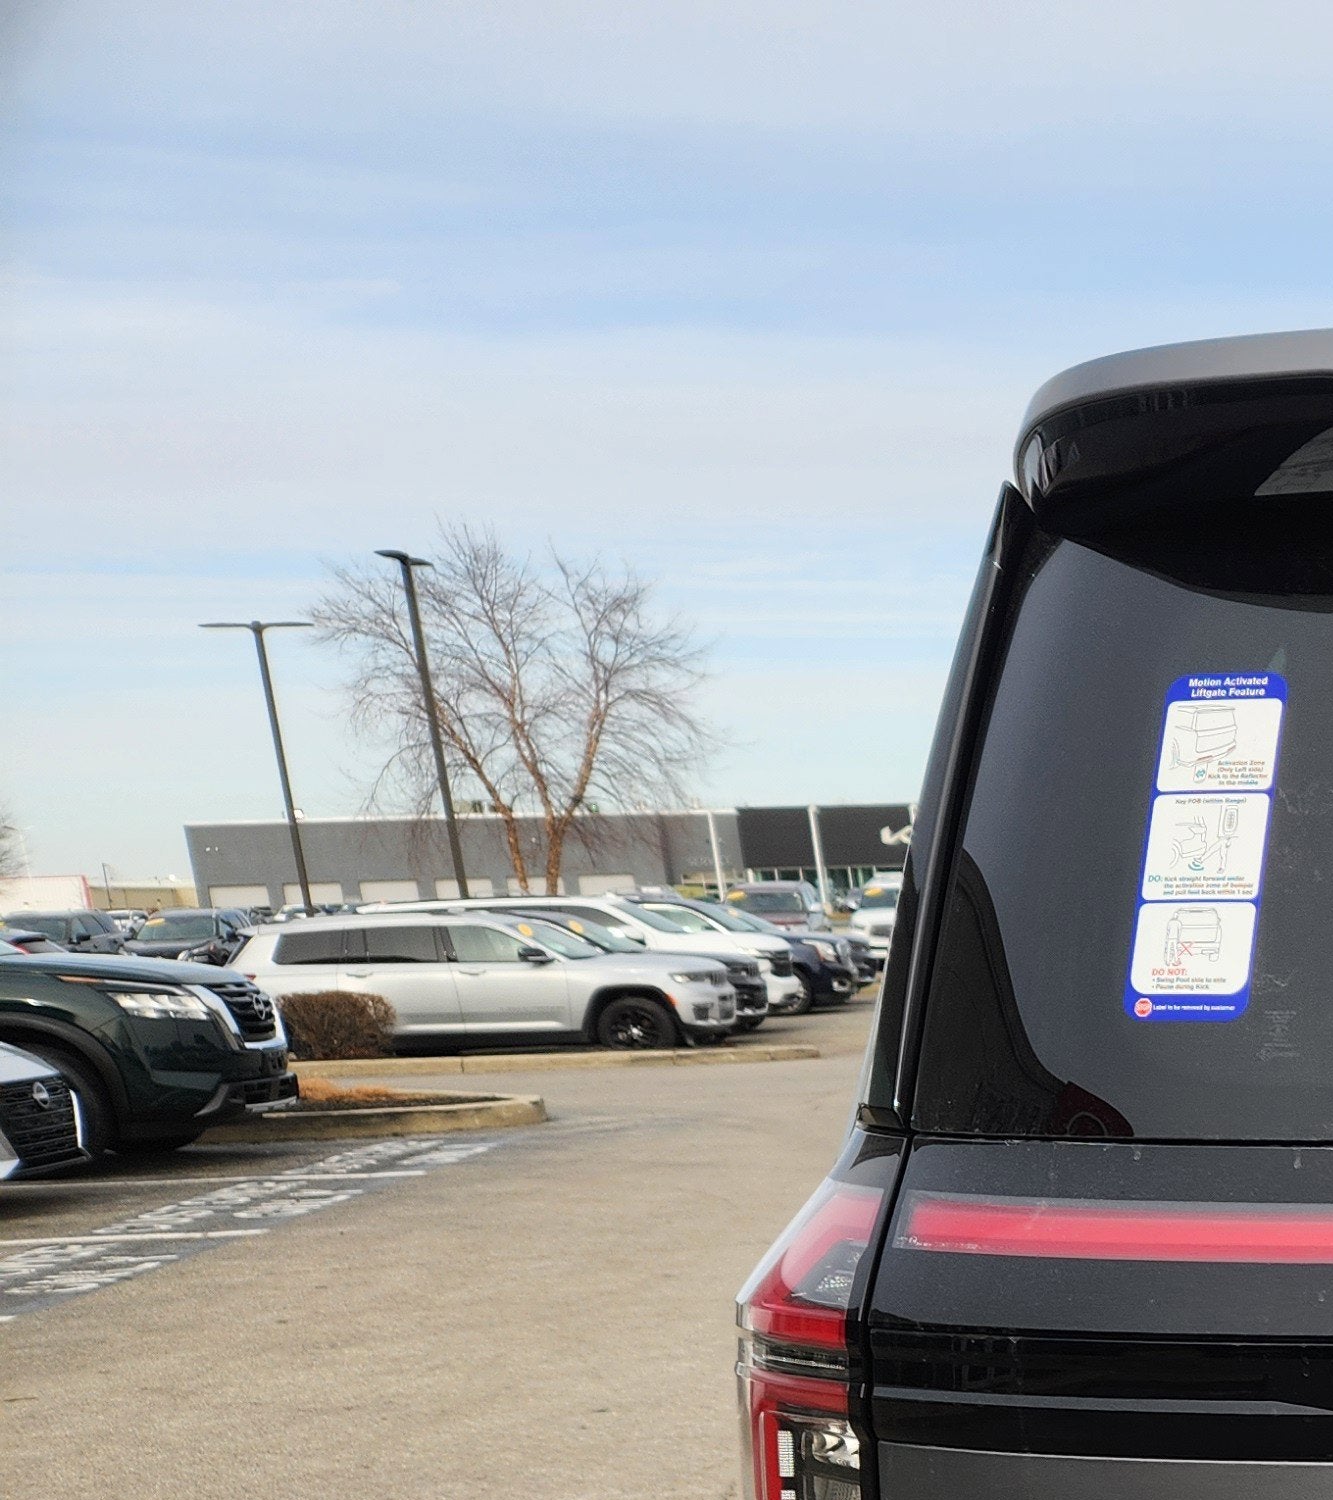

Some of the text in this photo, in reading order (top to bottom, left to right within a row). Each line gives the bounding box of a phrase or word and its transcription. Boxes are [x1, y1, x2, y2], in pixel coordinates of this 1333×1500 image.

[1188, 676, 1268, 687] Motion Activated
[1191, 687, 1265, 698] Liftgate Feature
[1152, 968, 1188, 976] DO NOT:
